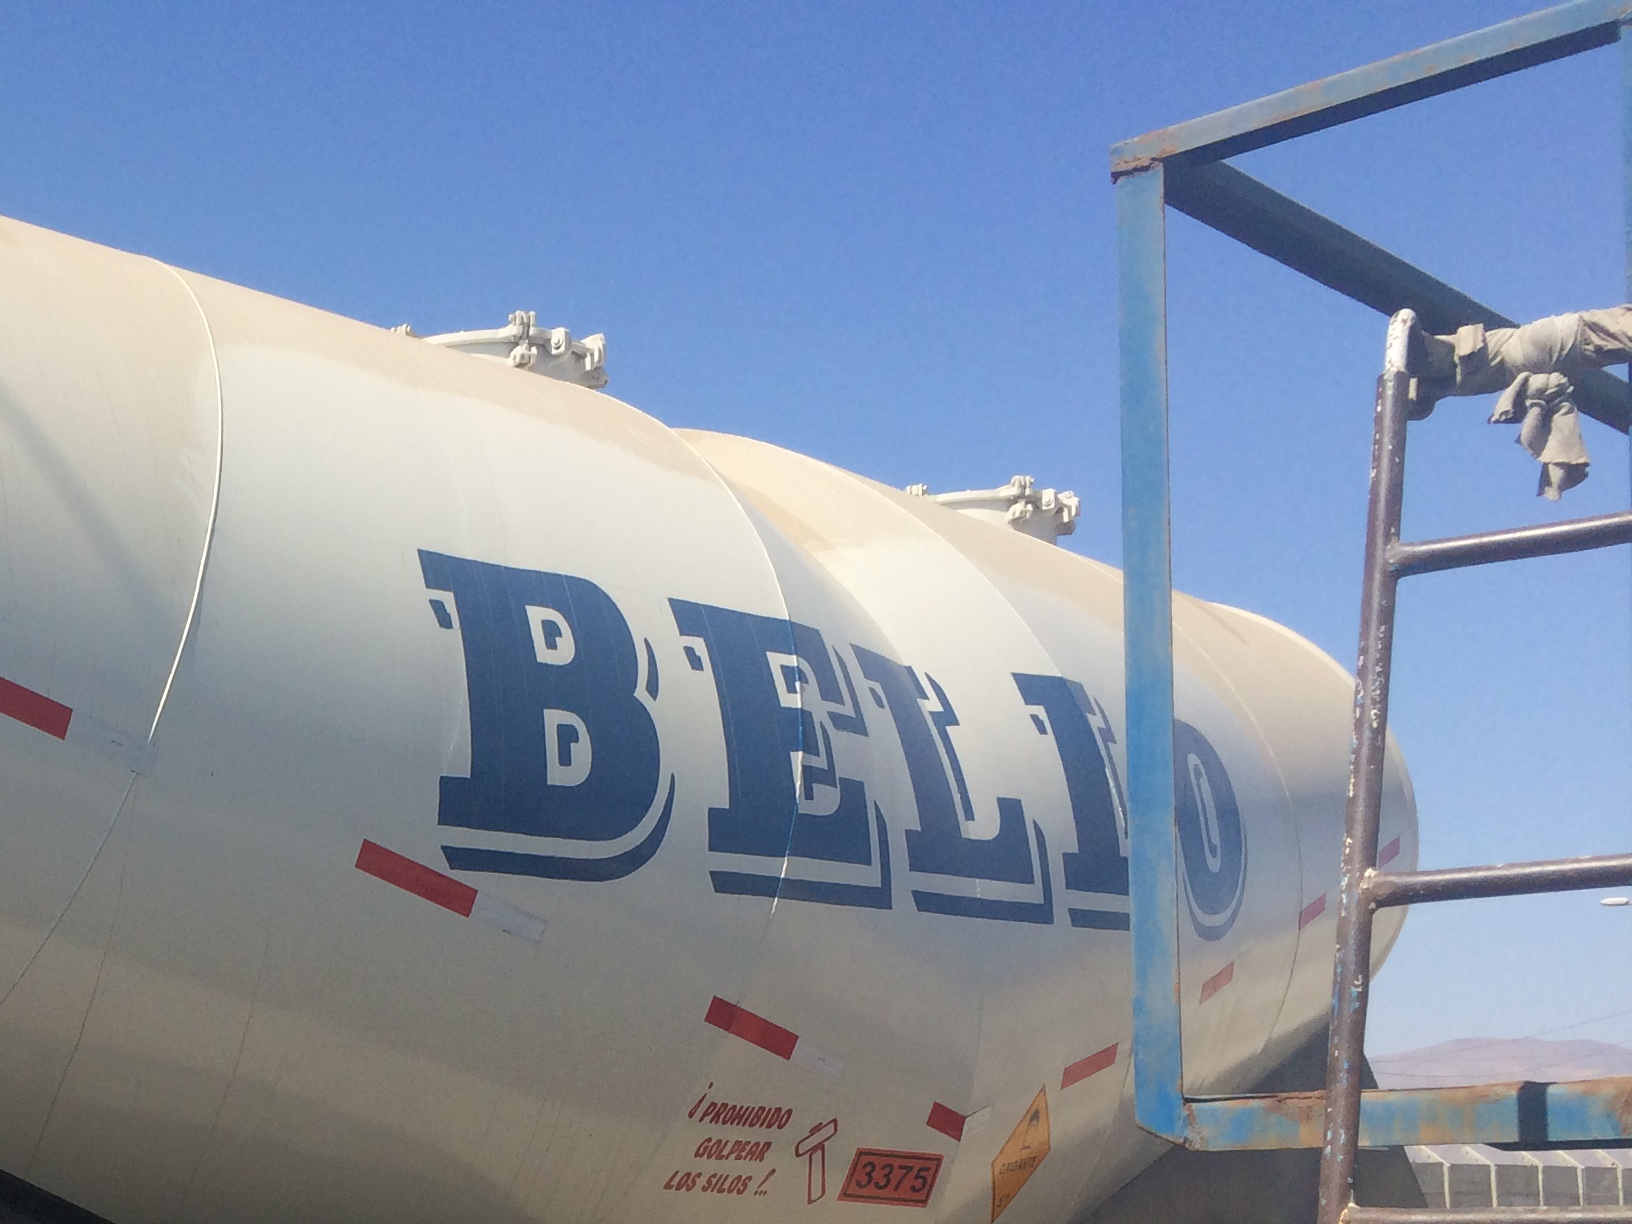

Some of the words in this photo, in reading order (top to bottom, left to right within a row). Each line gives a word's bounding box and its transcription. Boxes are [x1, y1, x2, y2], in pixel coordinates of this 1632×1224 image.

[694, 1137, 772, 1162] GOLPEAR
[663, 1170, 702, 1193] LOS
[701, 1173, 753, 1195] SILOS
[855, 1161, 932, 1194] 3375
